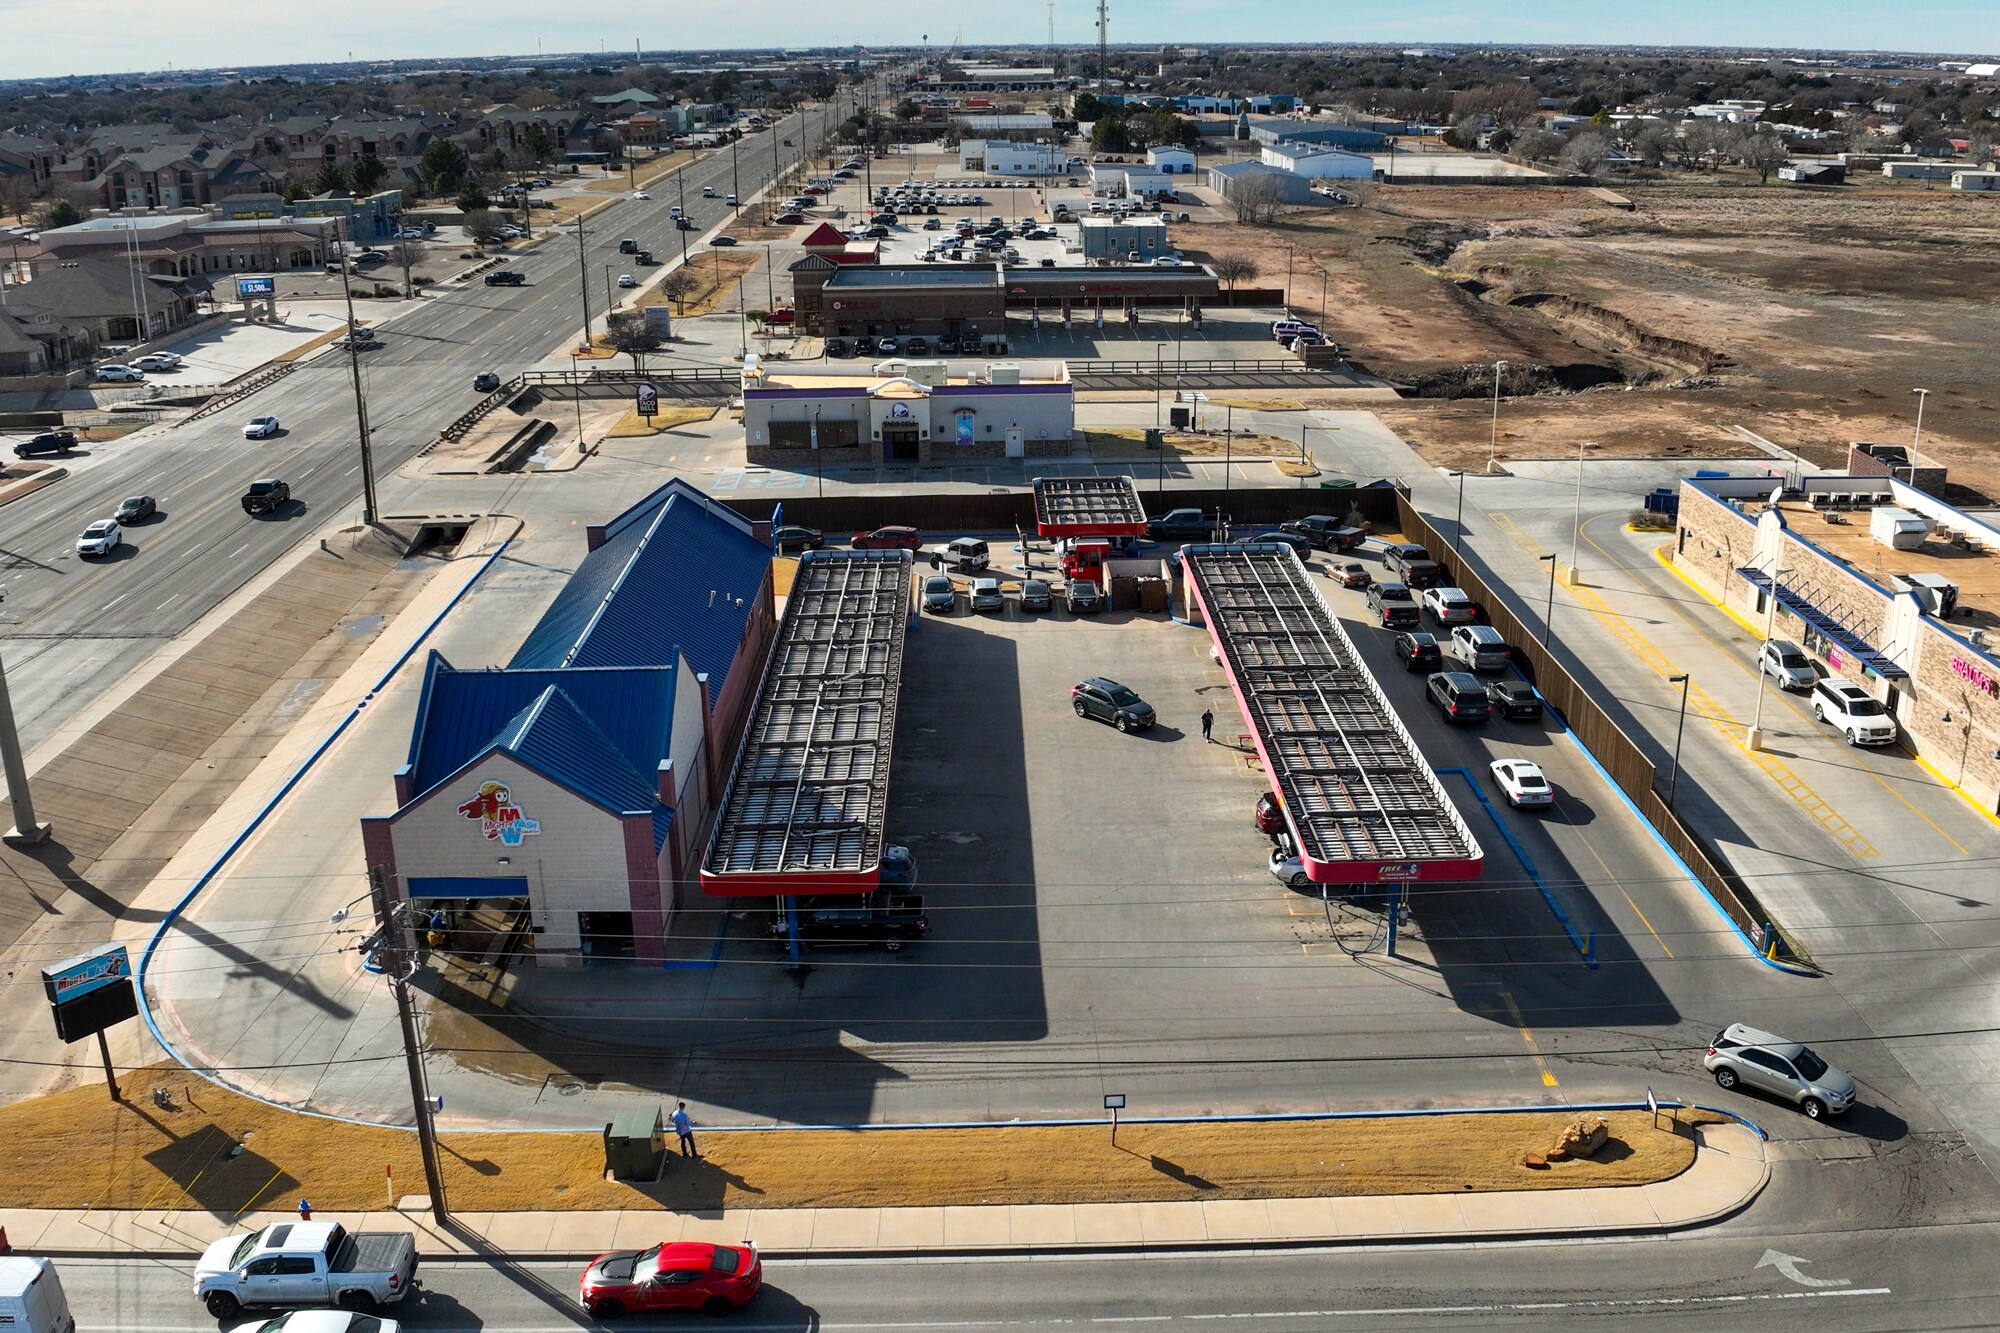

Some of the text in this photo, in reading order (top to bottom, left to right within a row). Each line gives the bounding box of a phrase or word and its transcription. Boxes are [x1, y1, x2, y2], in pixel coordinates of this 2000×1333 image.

[247, 284, 265, 292] $1,500
[1952, 655, 1992, 693] BRAUM'S
[1379, 865, 1402, 873] FREE
[58, 973, 88, 991] MIGHTY
